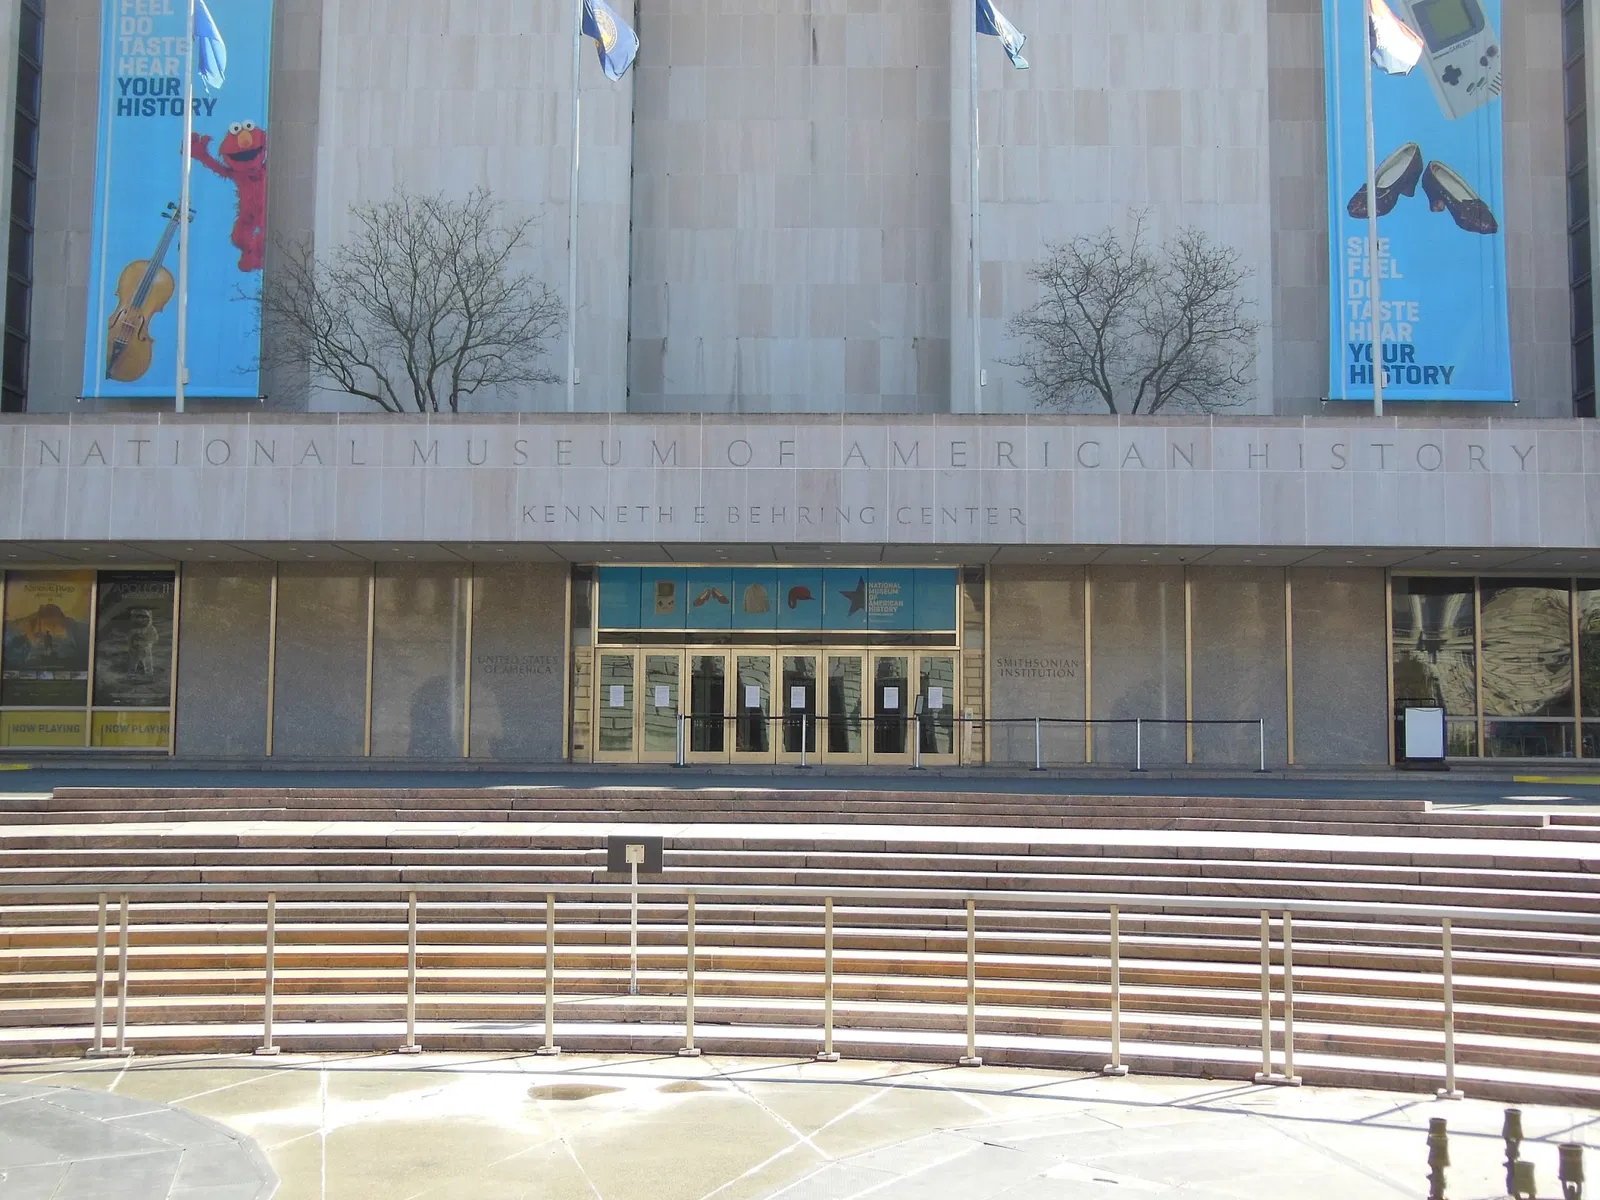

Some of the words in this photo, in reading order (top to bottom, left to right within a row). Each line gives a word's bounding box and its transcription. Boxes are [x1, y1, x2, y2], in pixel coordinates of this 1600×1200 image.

[121, 0, 174, 15] FEEL
[121, 17, 153, 36] DO
[119, 37, 189, 56] TASTE
[119, 58, 180, 76] HEAR
[118, 77, 181, 97] YOUR
[117, 98, 217, 117] HISTORY
[1348, 301, 1420, 321] TASTE
[1349, 343, 1415, 364] YOUR
[39, 439, 367, 466] NATIONAL
[411, 439, 678, 467] MUSEUM
[727, 439, 796, 467] OF
[842, 440, 1195, 469] AMERICAN
[1247, 442, 1536, 472] HISTORY
[522, 505, 674, 524] KENNETH
[727, 506, 876, 526] BEHRING
[896, 506, 1027, 527] CENTER
[996, 658, 1080, 668] SMITHSONIAN
[1000, 668, 1076, 678] INSTITUTION
[12, 724, 36, 733] NOW
[38, 724, 81, 733] PLAYING
[105, 725, 128, 733] NOW
